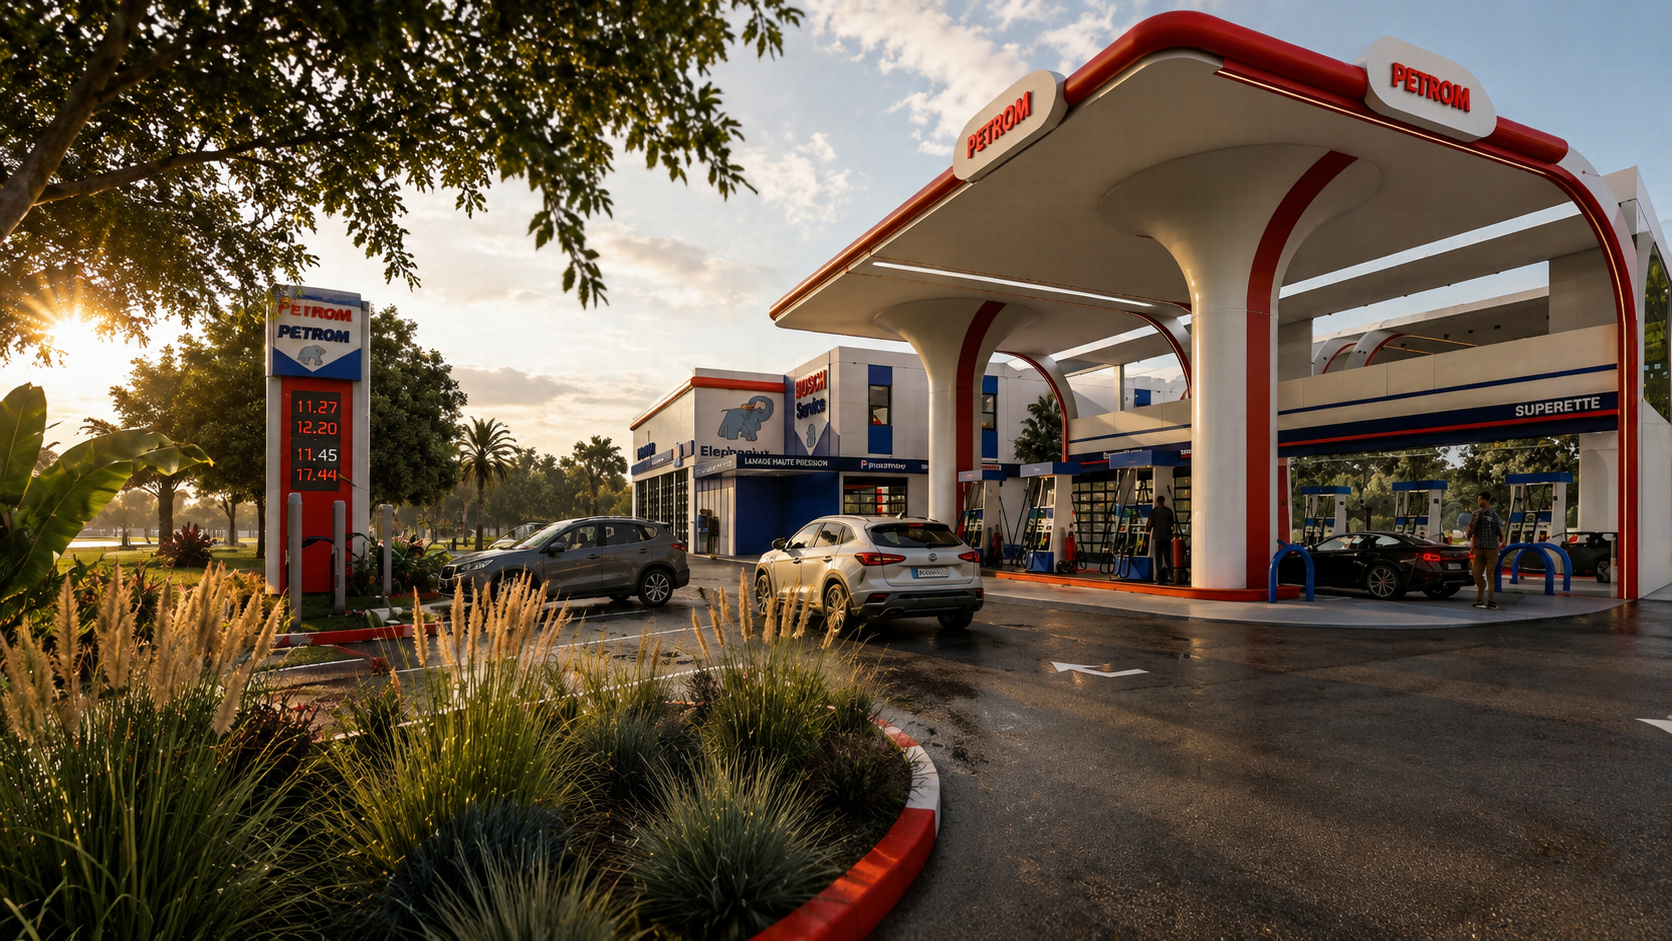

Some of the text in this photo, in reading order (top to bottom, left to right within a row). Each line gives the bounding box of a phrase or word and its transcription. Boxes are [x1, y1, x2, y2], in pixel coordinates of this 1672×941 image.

[1391, 62, 1470, 112] PETROM
[967, 90, 1032, 159] PETROM
[277, 324, 350, 343] PETROM
[297, 400, 338, 414] 11.27
[1515, 396, 1600, 417] SUPERETTE
[297, 420, 338, 435] 12.20
[297, 447, 338, 462] 11.45
[772, 458, 795, 466] HAUTE
[296, 468, 337, 482] 17.44
